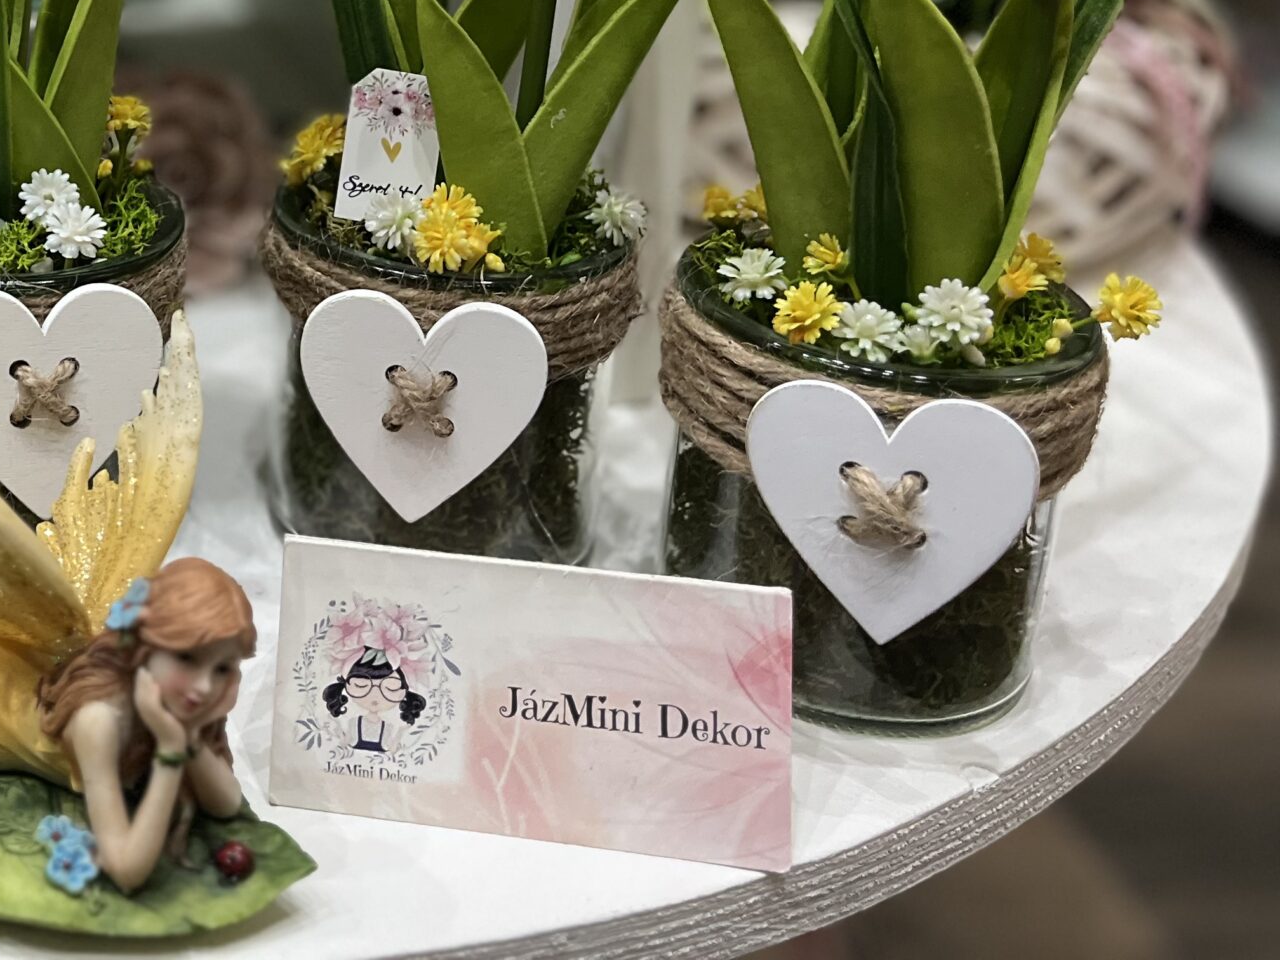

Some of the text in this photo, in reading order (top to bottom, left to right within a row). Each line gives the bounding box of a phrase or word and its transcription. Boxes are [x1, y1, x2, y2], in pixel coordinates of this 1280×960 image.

[498, 685, 770, 751] JázMini Dekor
[323, 760, 418, 785] JázMini Dekor
